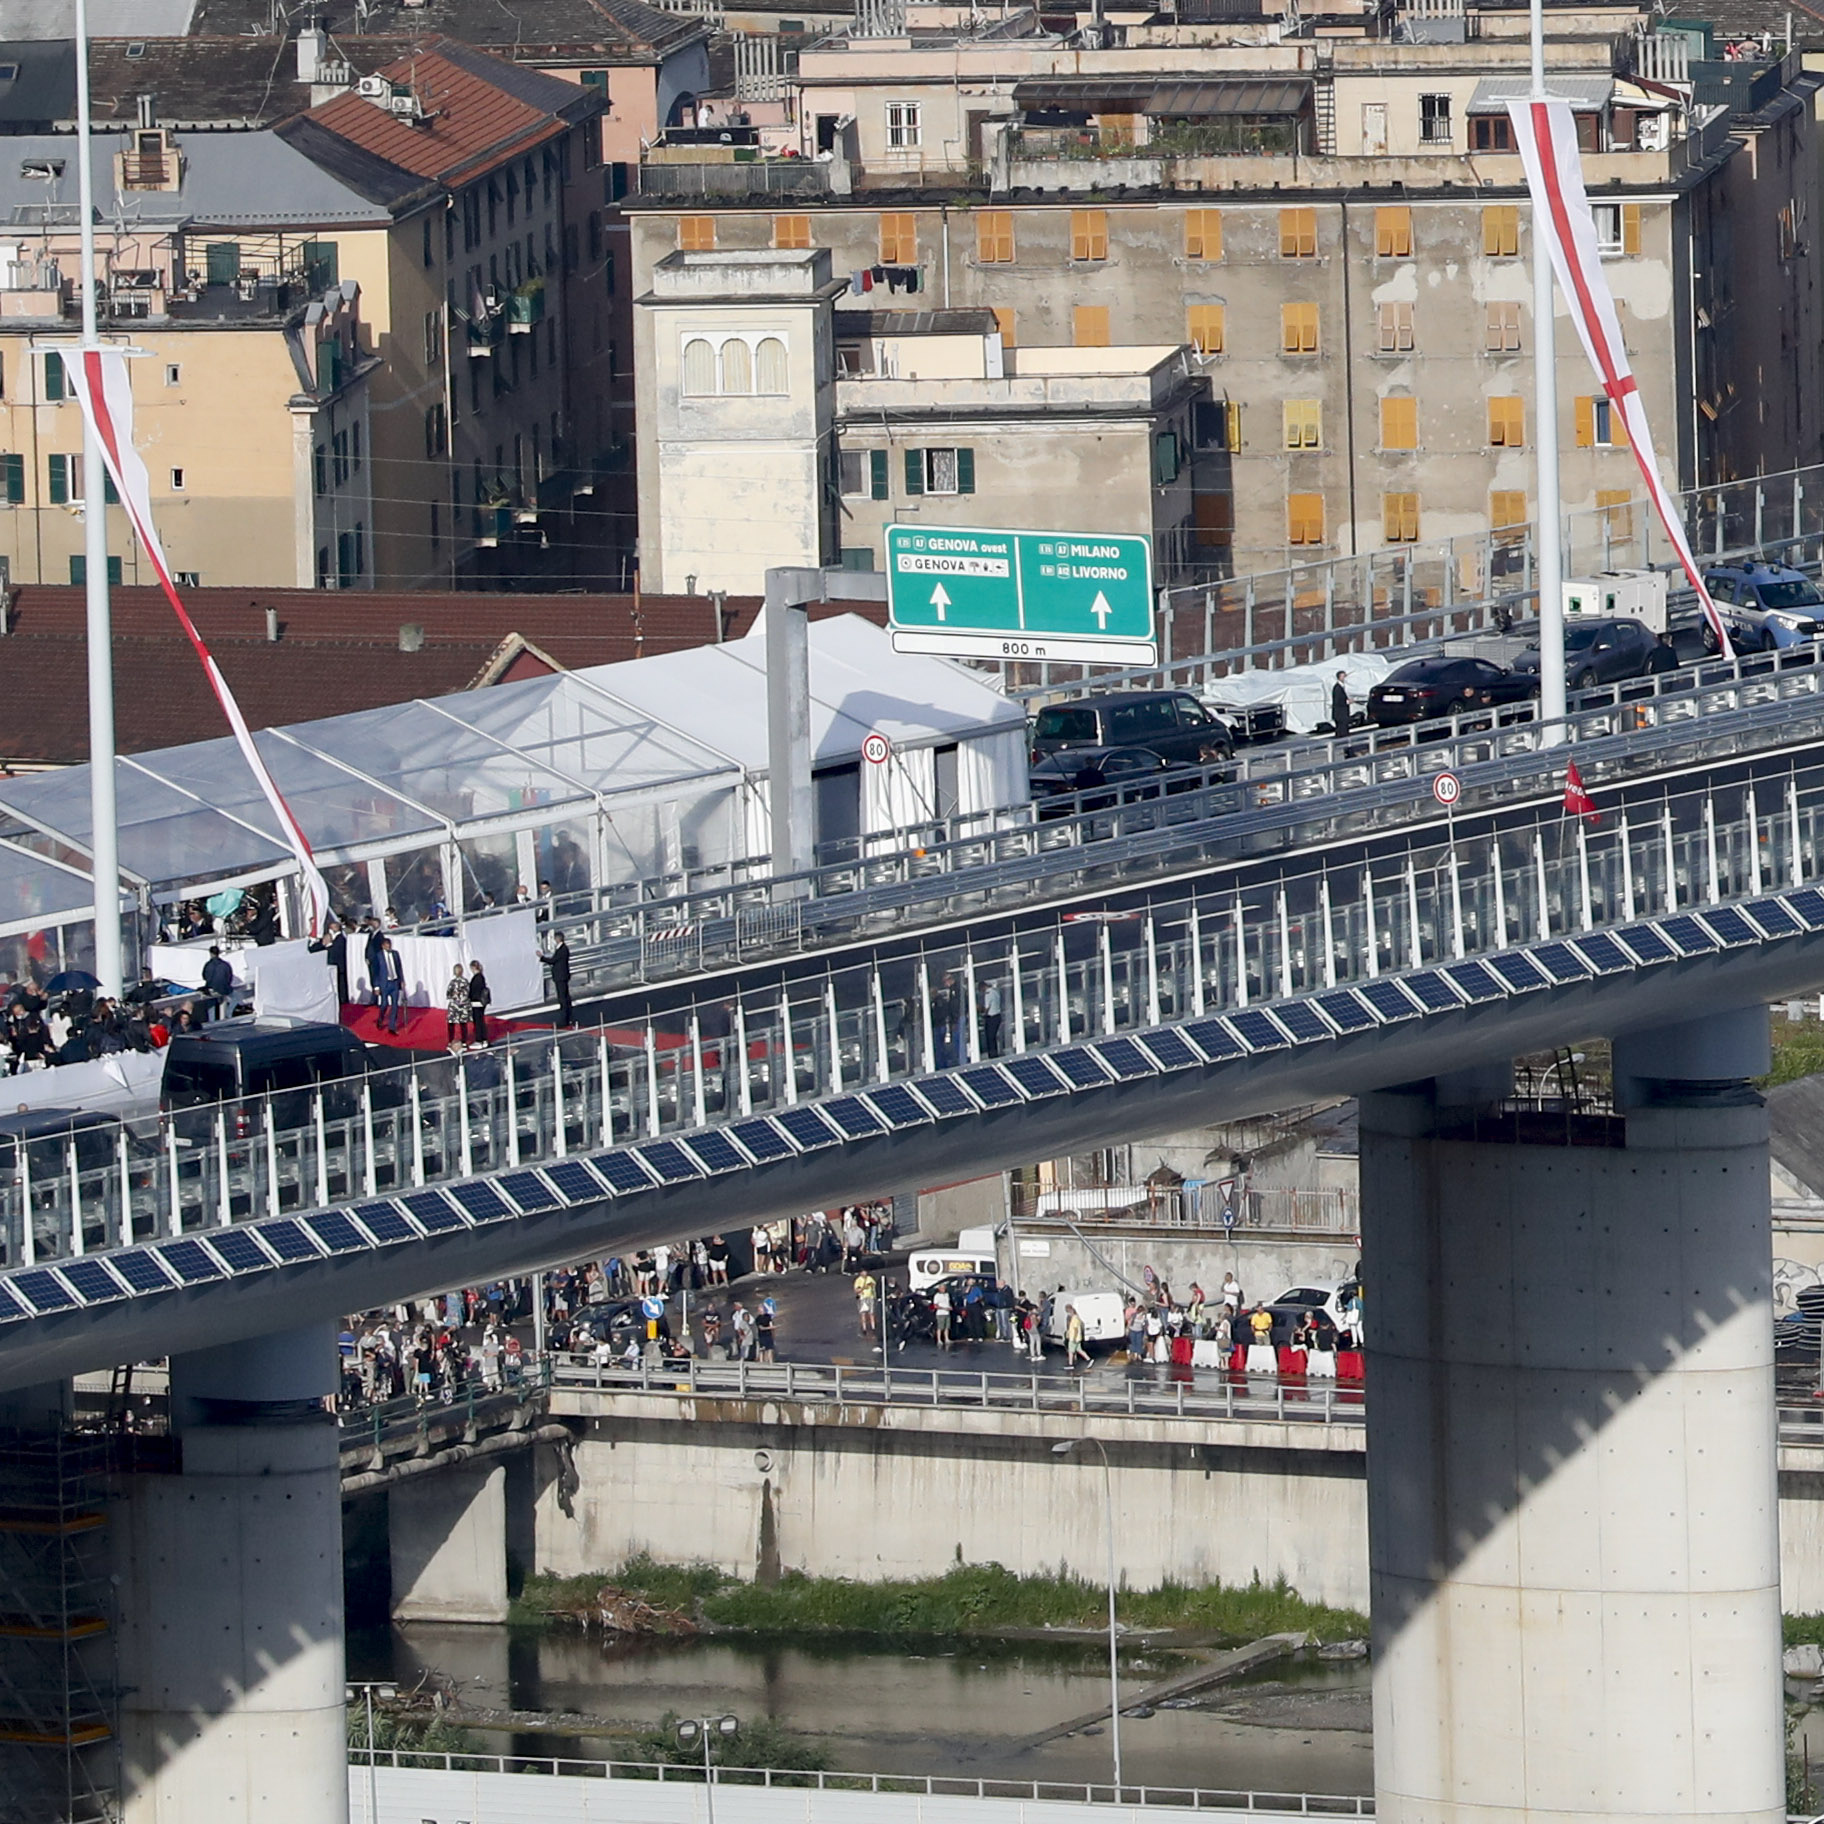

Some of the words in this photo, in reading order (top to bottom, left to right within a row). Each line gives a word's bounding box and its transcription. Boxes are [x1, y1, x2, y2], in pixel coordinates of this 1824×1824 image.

[928, 537, 978, 552] GENOVA
[981, 543, 1007, 554] ovest
[1071, 544, 1120, 559] MILANO
[915, 558, 965, 571] GENOVA
[1072, 565, 1128, 581] LIVORNO
[1002, 642, 1030, 655] 800
[1035, 647, 1046, 656] m
[869, 742, 883, 756] 80
[1440, 781, 1454, 795] 80
